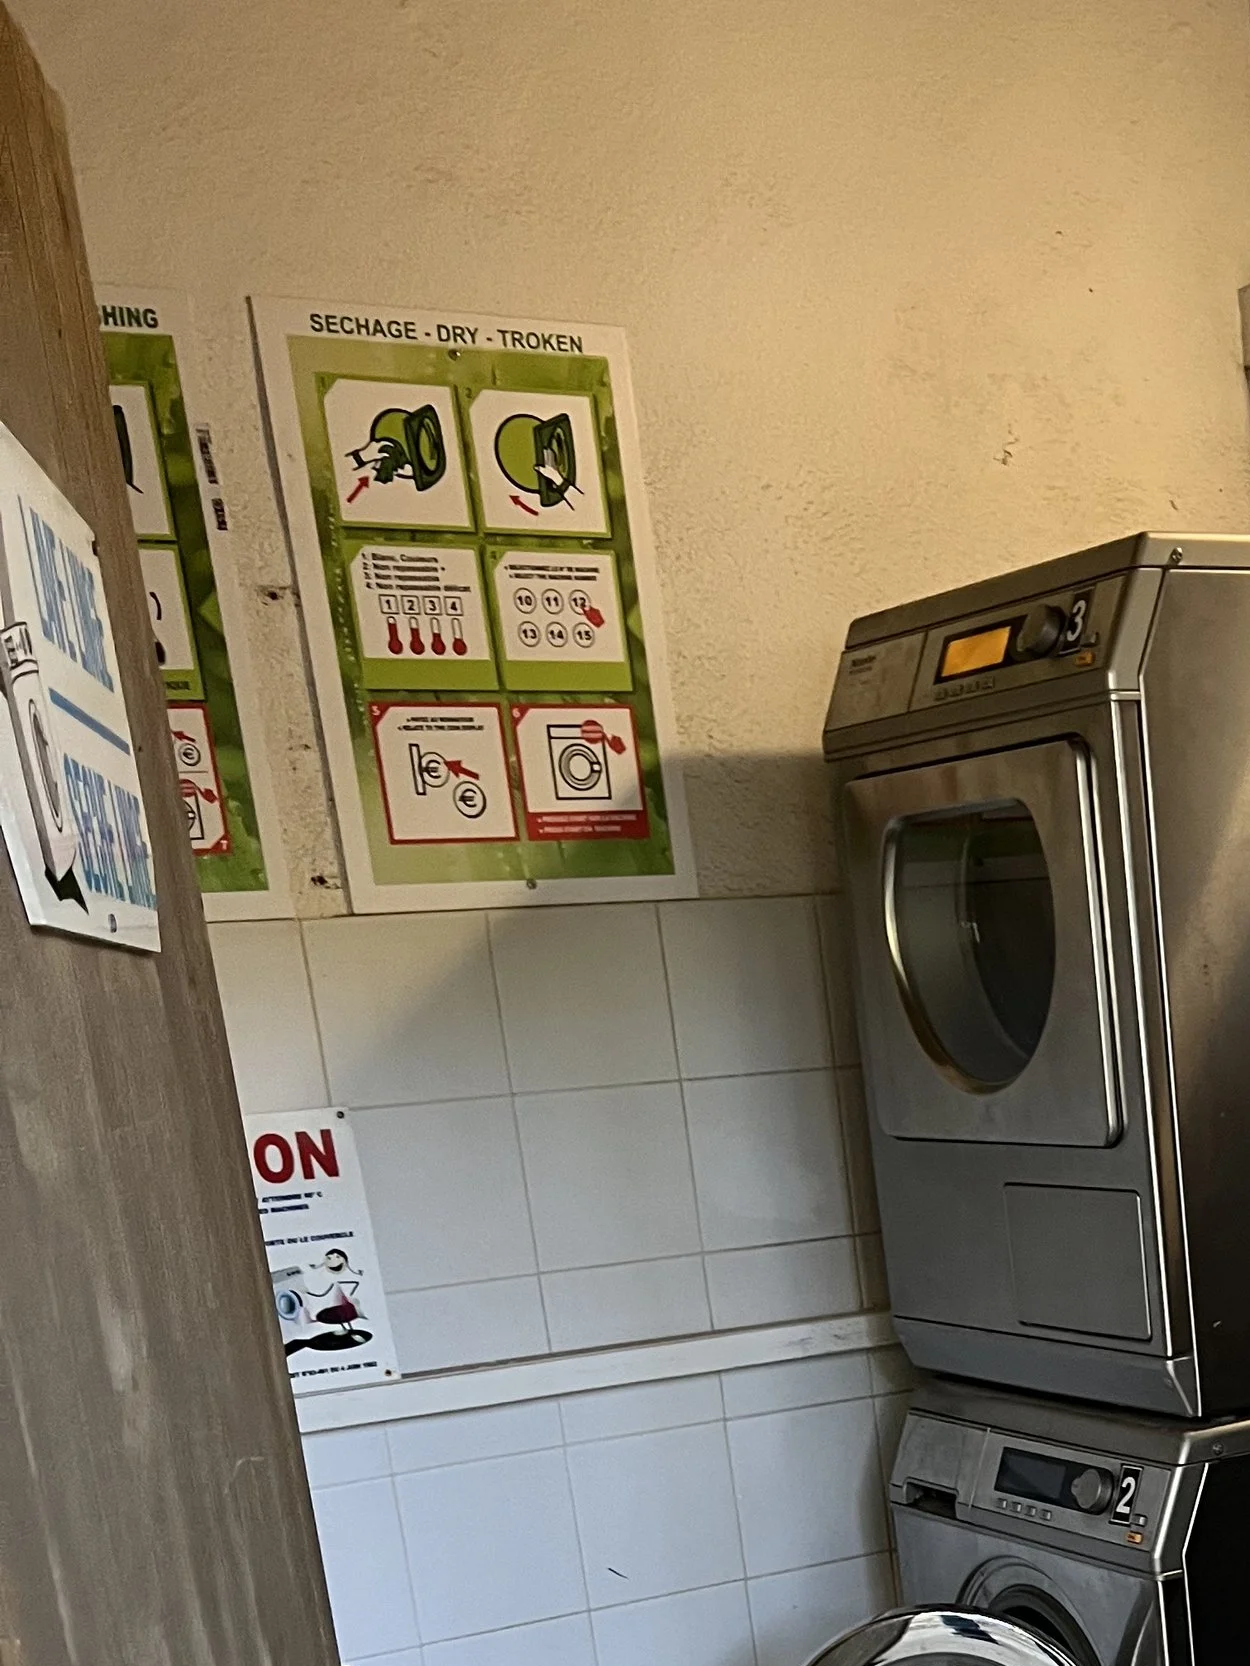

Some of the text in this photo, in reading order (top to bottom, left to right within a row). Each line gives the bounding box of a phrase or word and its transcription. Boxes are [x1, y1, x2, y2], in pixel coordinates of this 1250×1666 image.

[99, 304, 159, 329] HING
[309, 313, 418, 340] SECHAGE
[436, 324, 479, 345] DRY
[497, 329, 584, 354] TROKEN
[384, 599, 458, 612] 1 2 3 4
[516, 595, 587, 608] 10 11 12
[1066, 599, 1086, 642] 3
[522, 628, 592, 641] 13 14 15
[511, 707, 521, 718] 6
[253, 1128, 340, 1185] ON
[1115, 1476, 1136, 1514] 2
